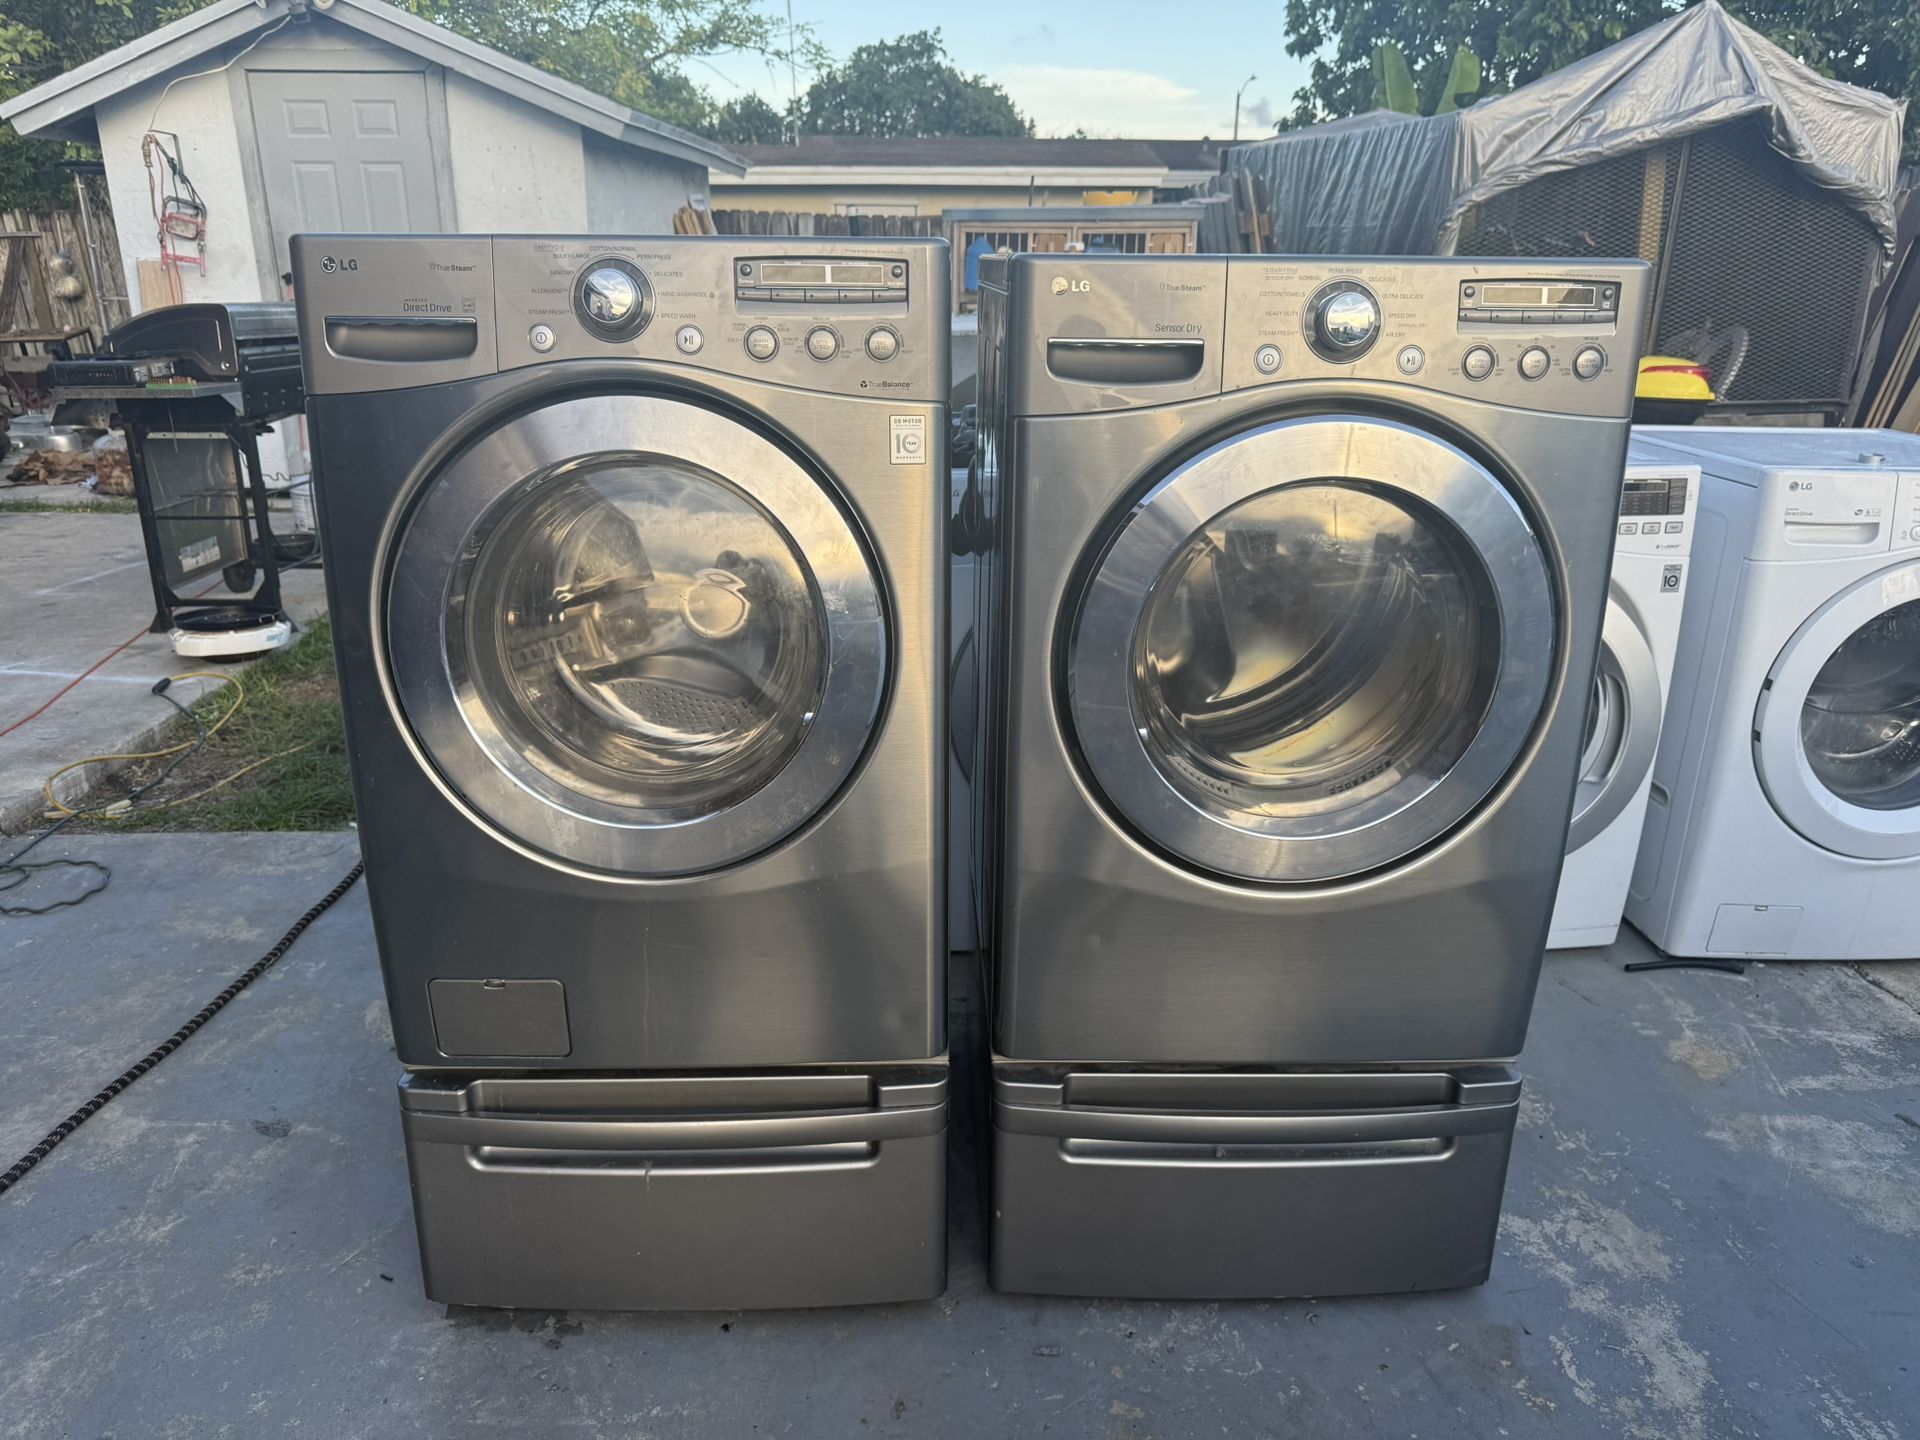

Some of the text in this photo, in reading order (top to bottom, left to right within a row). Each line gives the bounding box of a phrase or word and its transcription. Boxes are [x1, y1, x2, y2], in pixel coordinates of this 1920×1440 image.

[340, 258, 359, 271] LG
[1071, 281, 1090, 292] LG
[403, 302, 452, 312] Direct Drive
[1155, 323, 1202, 335] Sensor Dry
[1801, 482, 1813, 491] LG
[1663, 574, 1679, 588] 10
